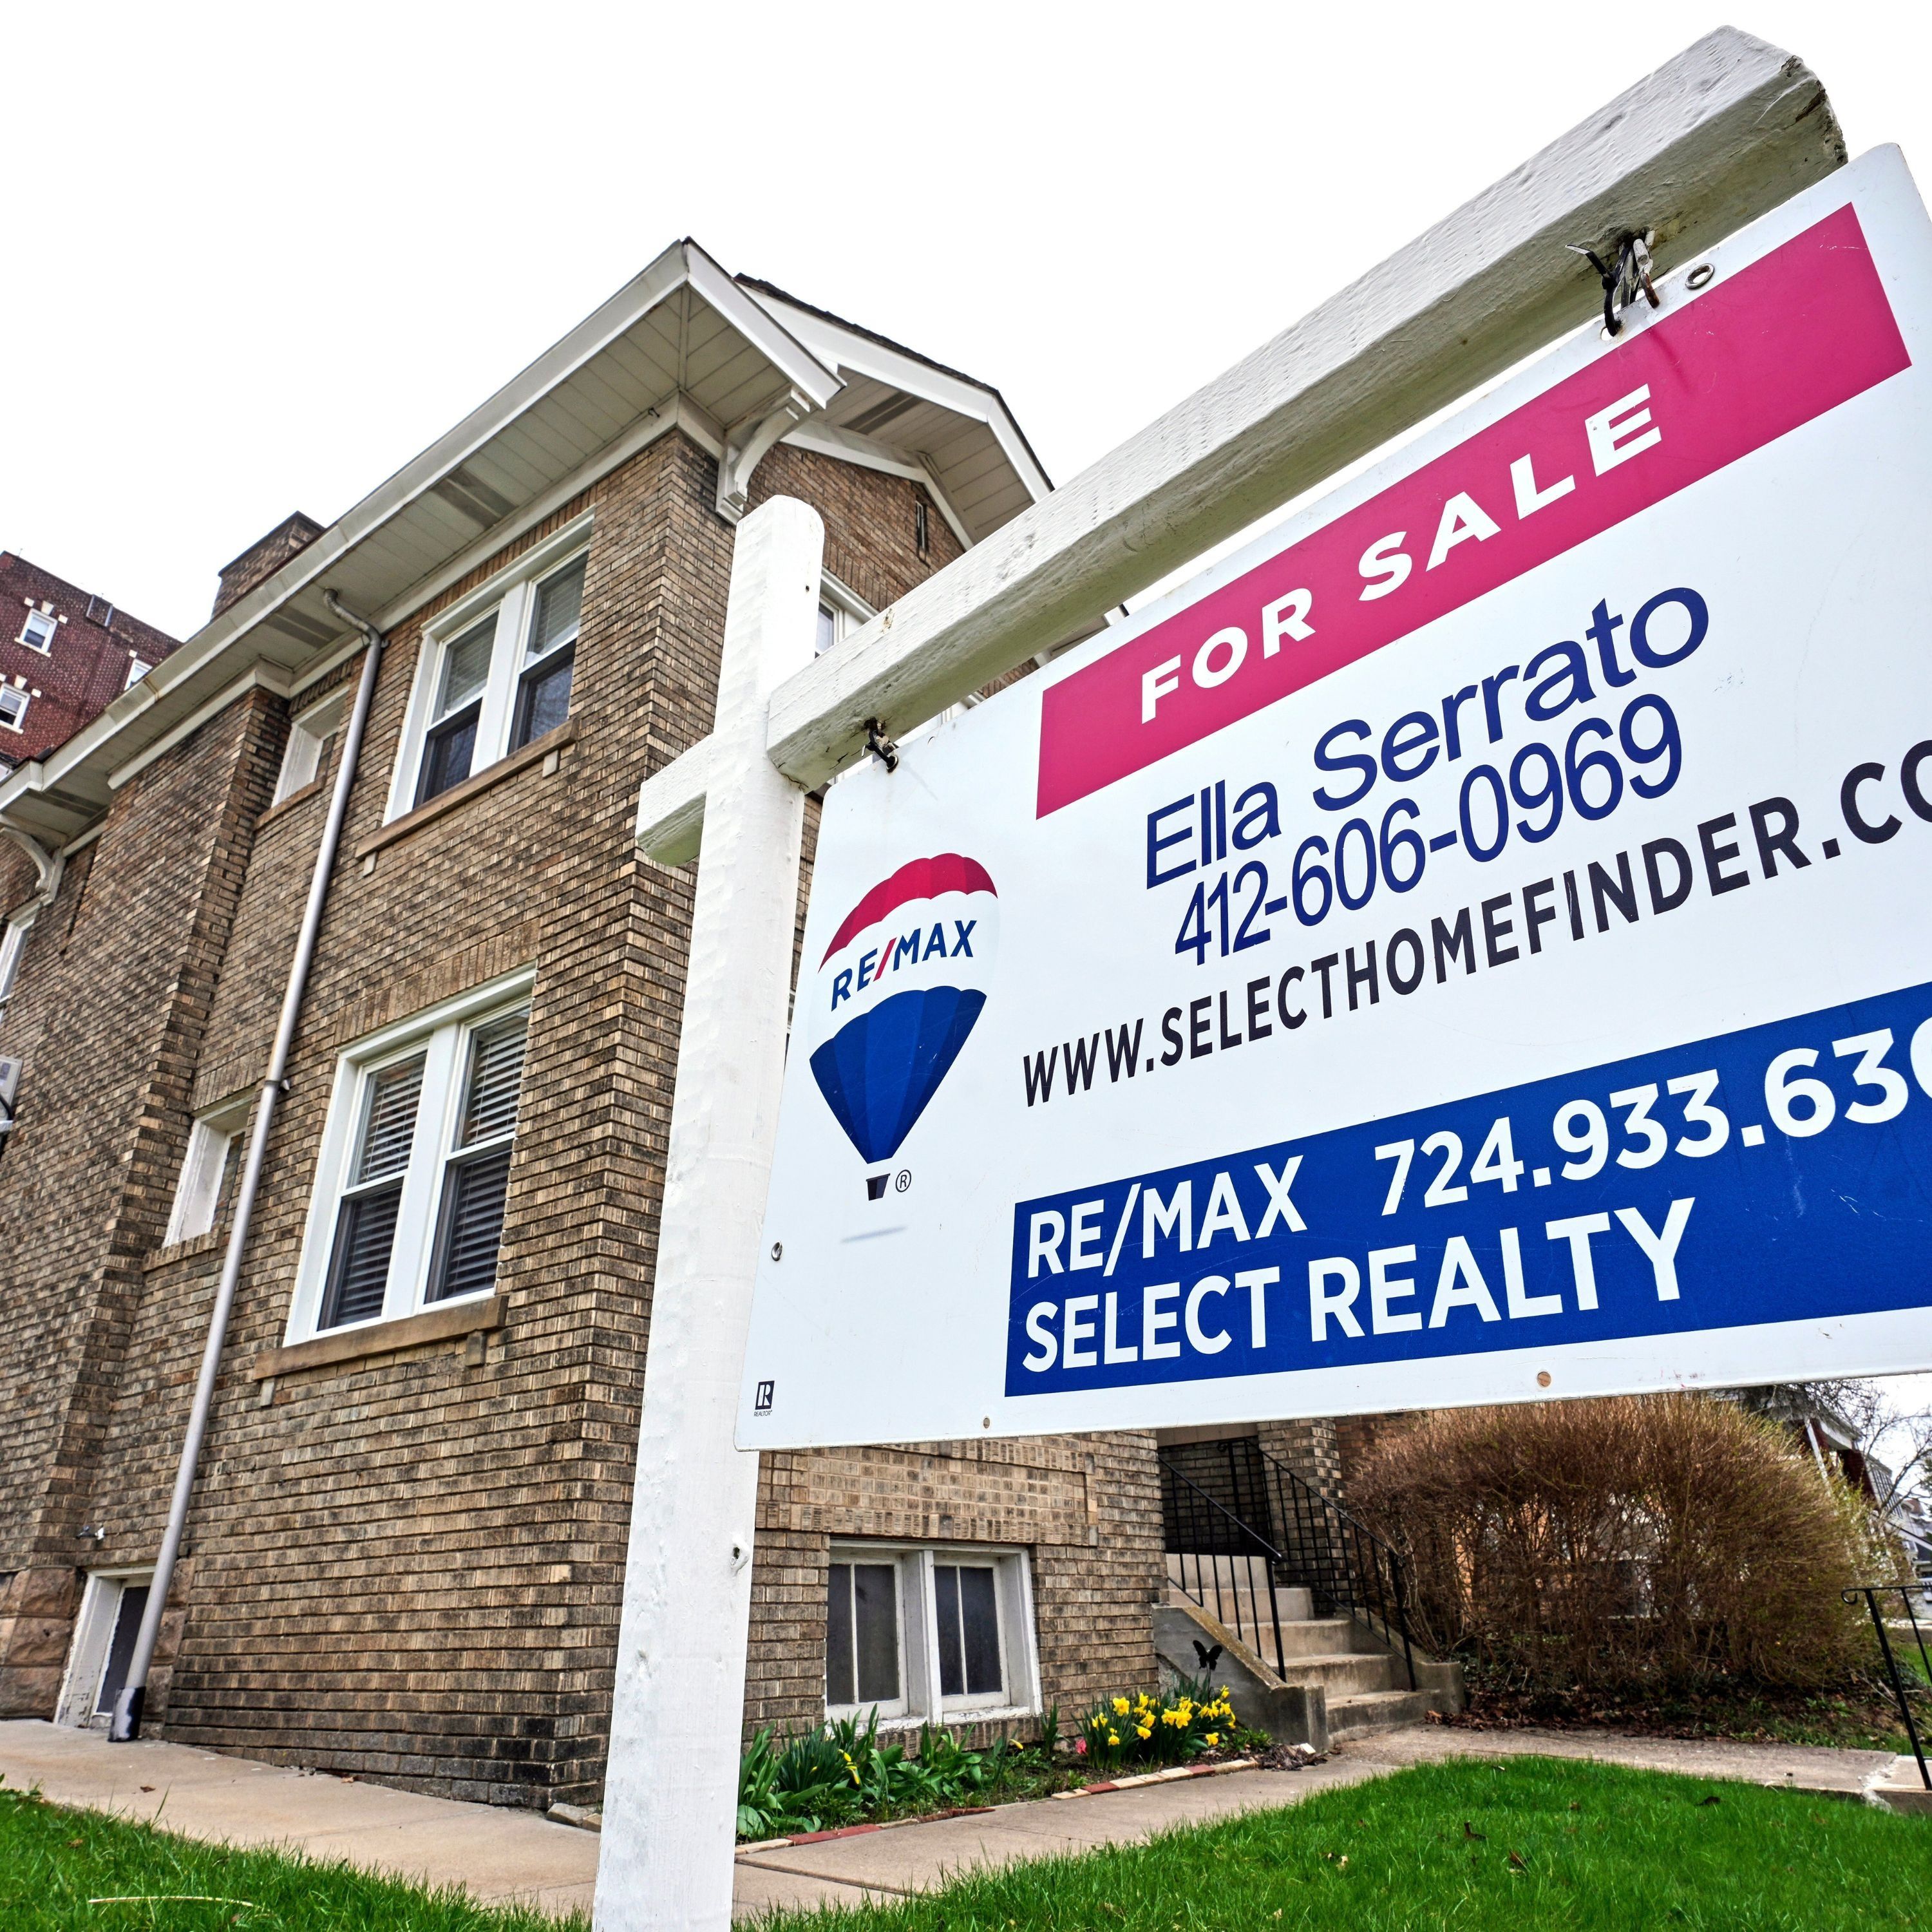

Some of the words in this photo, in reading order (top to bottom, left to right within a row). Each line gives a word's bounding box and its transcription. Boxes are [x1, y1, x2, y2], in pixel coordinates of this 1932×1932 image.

[1141, 588, 1316, 724] FOR
[1358, 383, 1662, 601] SALE
[1146, 779, 1282, 890] Ella
[1312, 587, 1709, 811] Serrato
[1175, 694, 1682, 966] 412-606-0969
[831, 920, 978, 1012] RE/MAX
[1028, 1155, 1308, 1278] RE/MAX
[1374, 1017, 1932, 1216] 724.933.63
[1022, 1266, 1280, 1372] SELECT
[1308, 1197, 1696, 1342] REALTY
